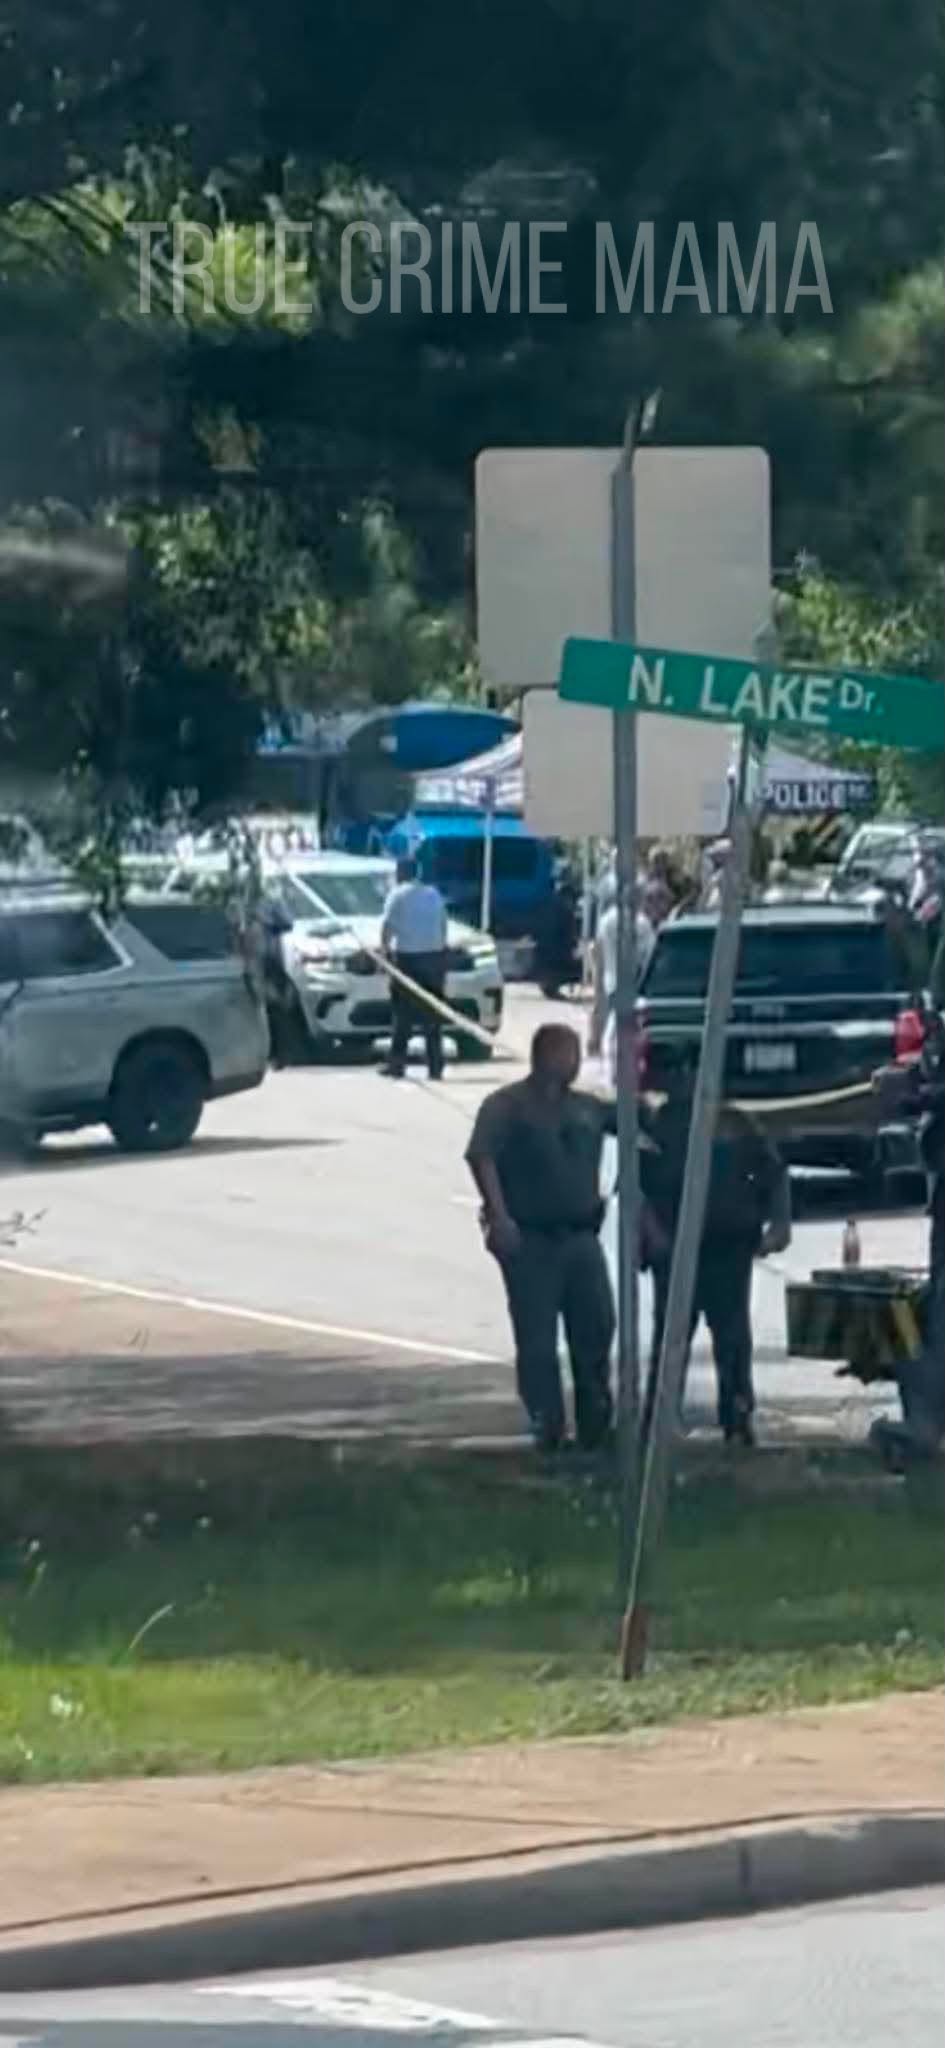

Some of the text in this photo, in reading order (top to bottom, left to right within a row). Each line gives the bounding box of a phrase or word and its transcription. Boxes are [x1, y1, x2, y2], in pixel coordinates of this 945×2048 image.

[627, 655, 885, 723] N. LAKE Dr.
